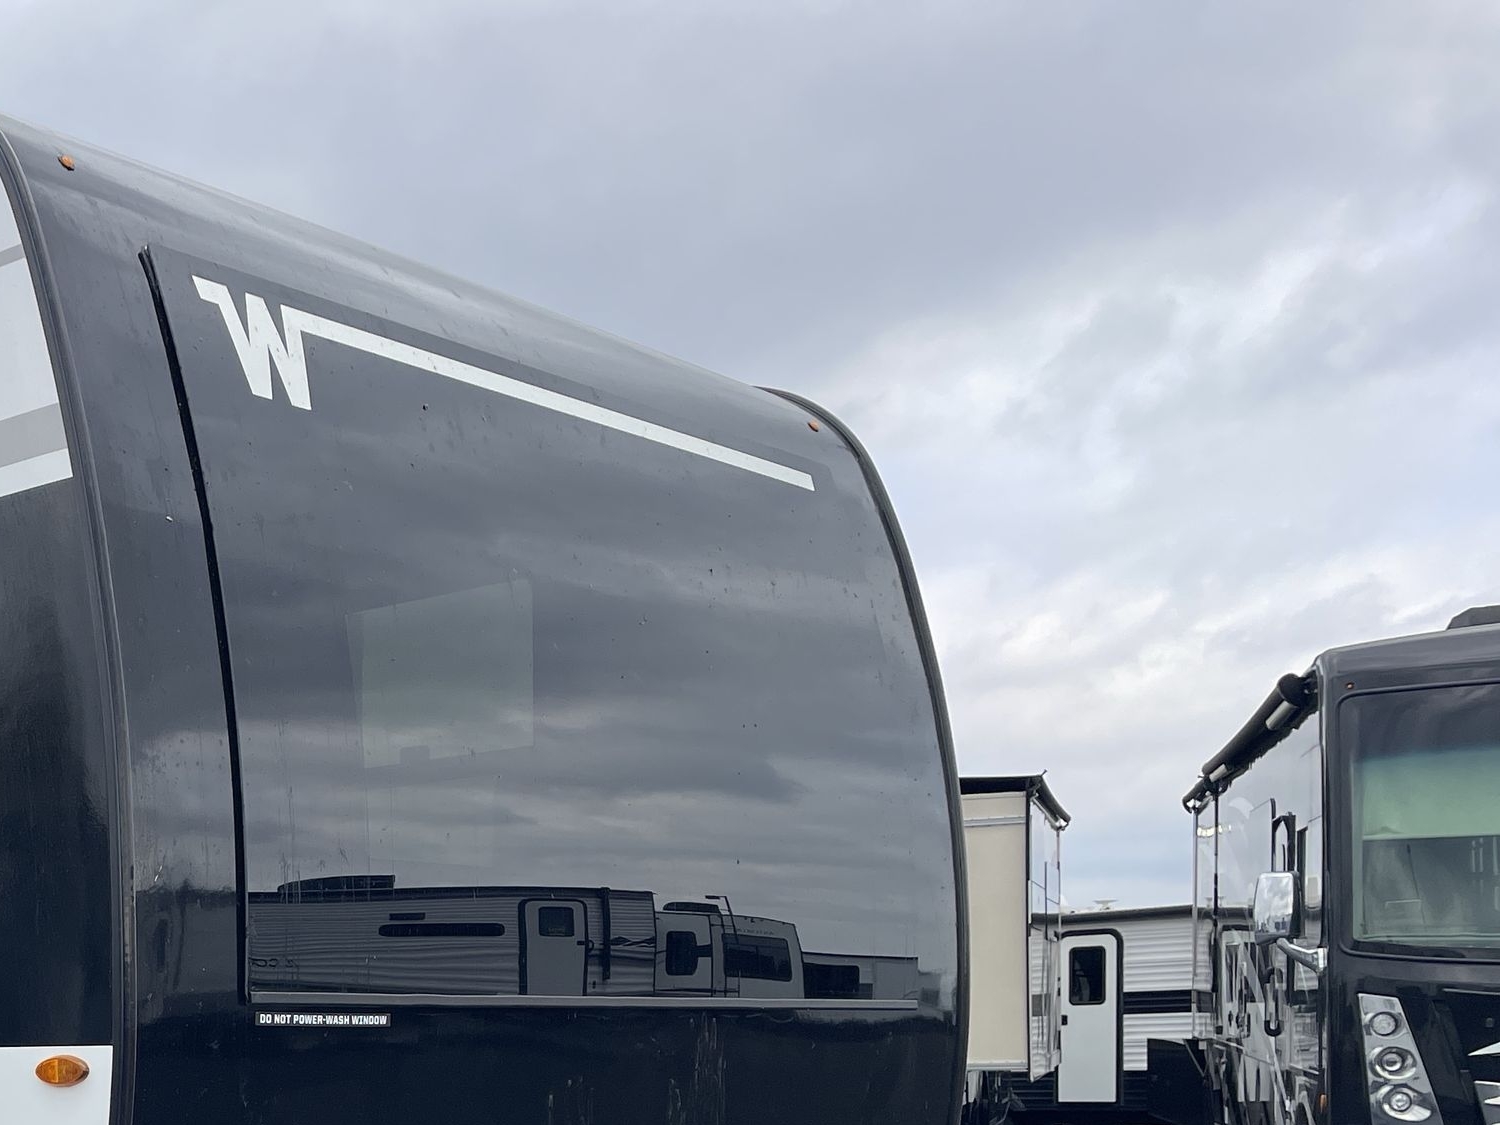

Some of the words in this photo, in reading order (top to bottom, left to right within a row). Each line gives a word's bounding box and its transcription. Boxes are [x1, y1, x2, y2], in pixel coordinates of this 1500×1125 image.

[259, 1013, 272, 1025] DO
[273, 1013, 292, 1025] NOT
[293, 1014, 350, 1026] POWER-WASH
[351, 1015, 388, 1026] WINDOW
